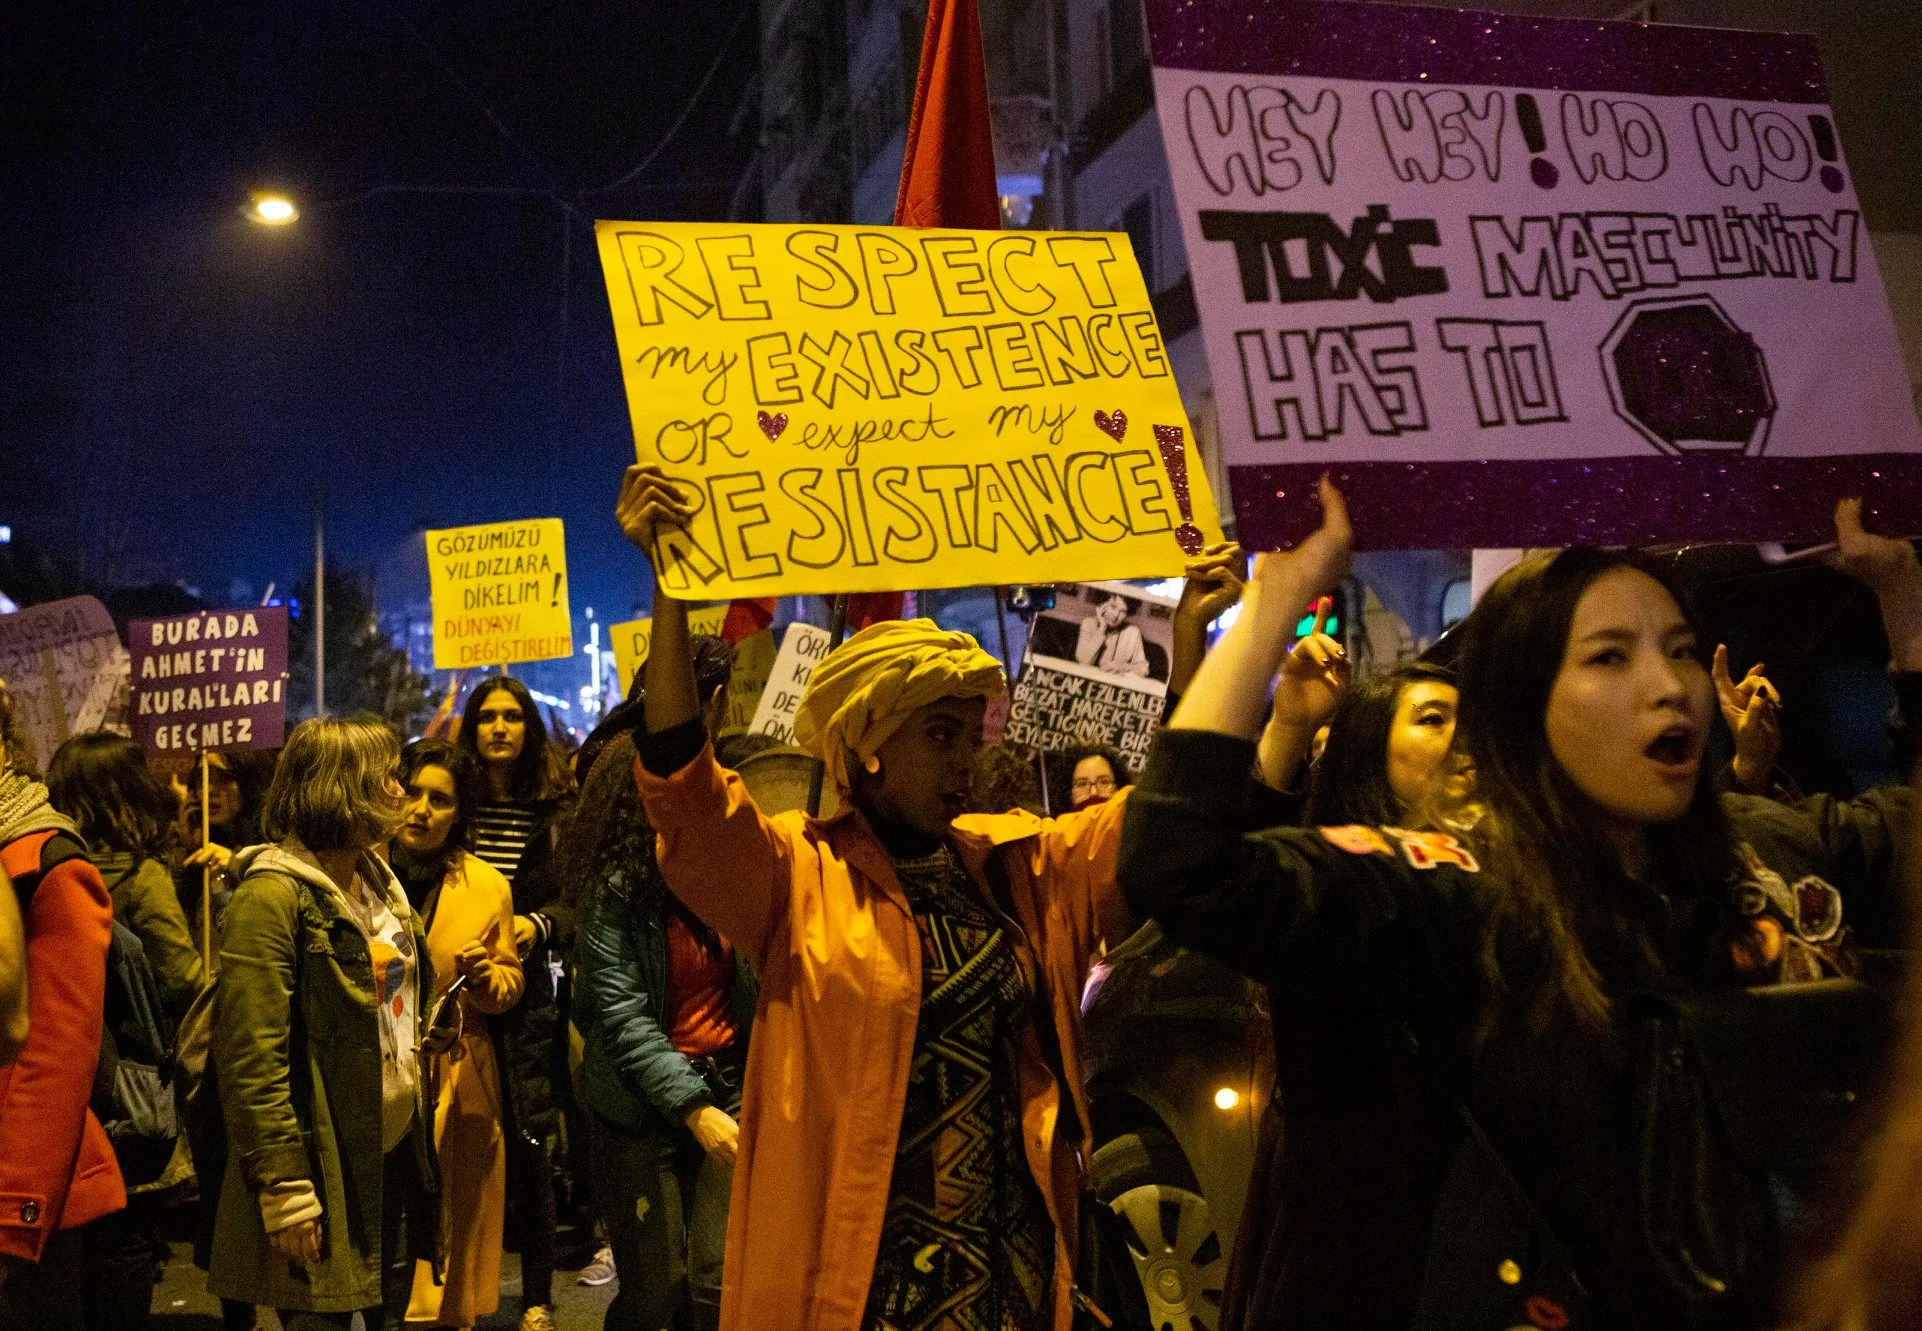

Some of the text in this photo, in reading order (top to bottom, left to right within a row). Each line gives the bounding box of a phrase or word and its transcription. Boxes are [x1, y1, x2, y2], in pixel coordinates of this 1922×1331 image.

[1185, 84, 1343, 196] HEY
[1560, 93, 1669, 185] HO
[616, 229, 1117, 327] RESPECT
[636, 311, 1169, 409] my EXISTENCE
[1235, 320, 1429, 441] HAS
[1435, 317, 1570, 428] TO
[656, 402, 1077, 466] OR expect my
[651, 424, 1206, 590] RESISTANCE!
[437, 524, 541, 556] GÖZÜMÜZÜ
[445, 554, 551, 581] YILDIZLARA
[152, 614, 259, 646] BURADA
[1023, 666, 1085, 696] ANCAK
[155, 718, 252, 752] GEÇMEZ
